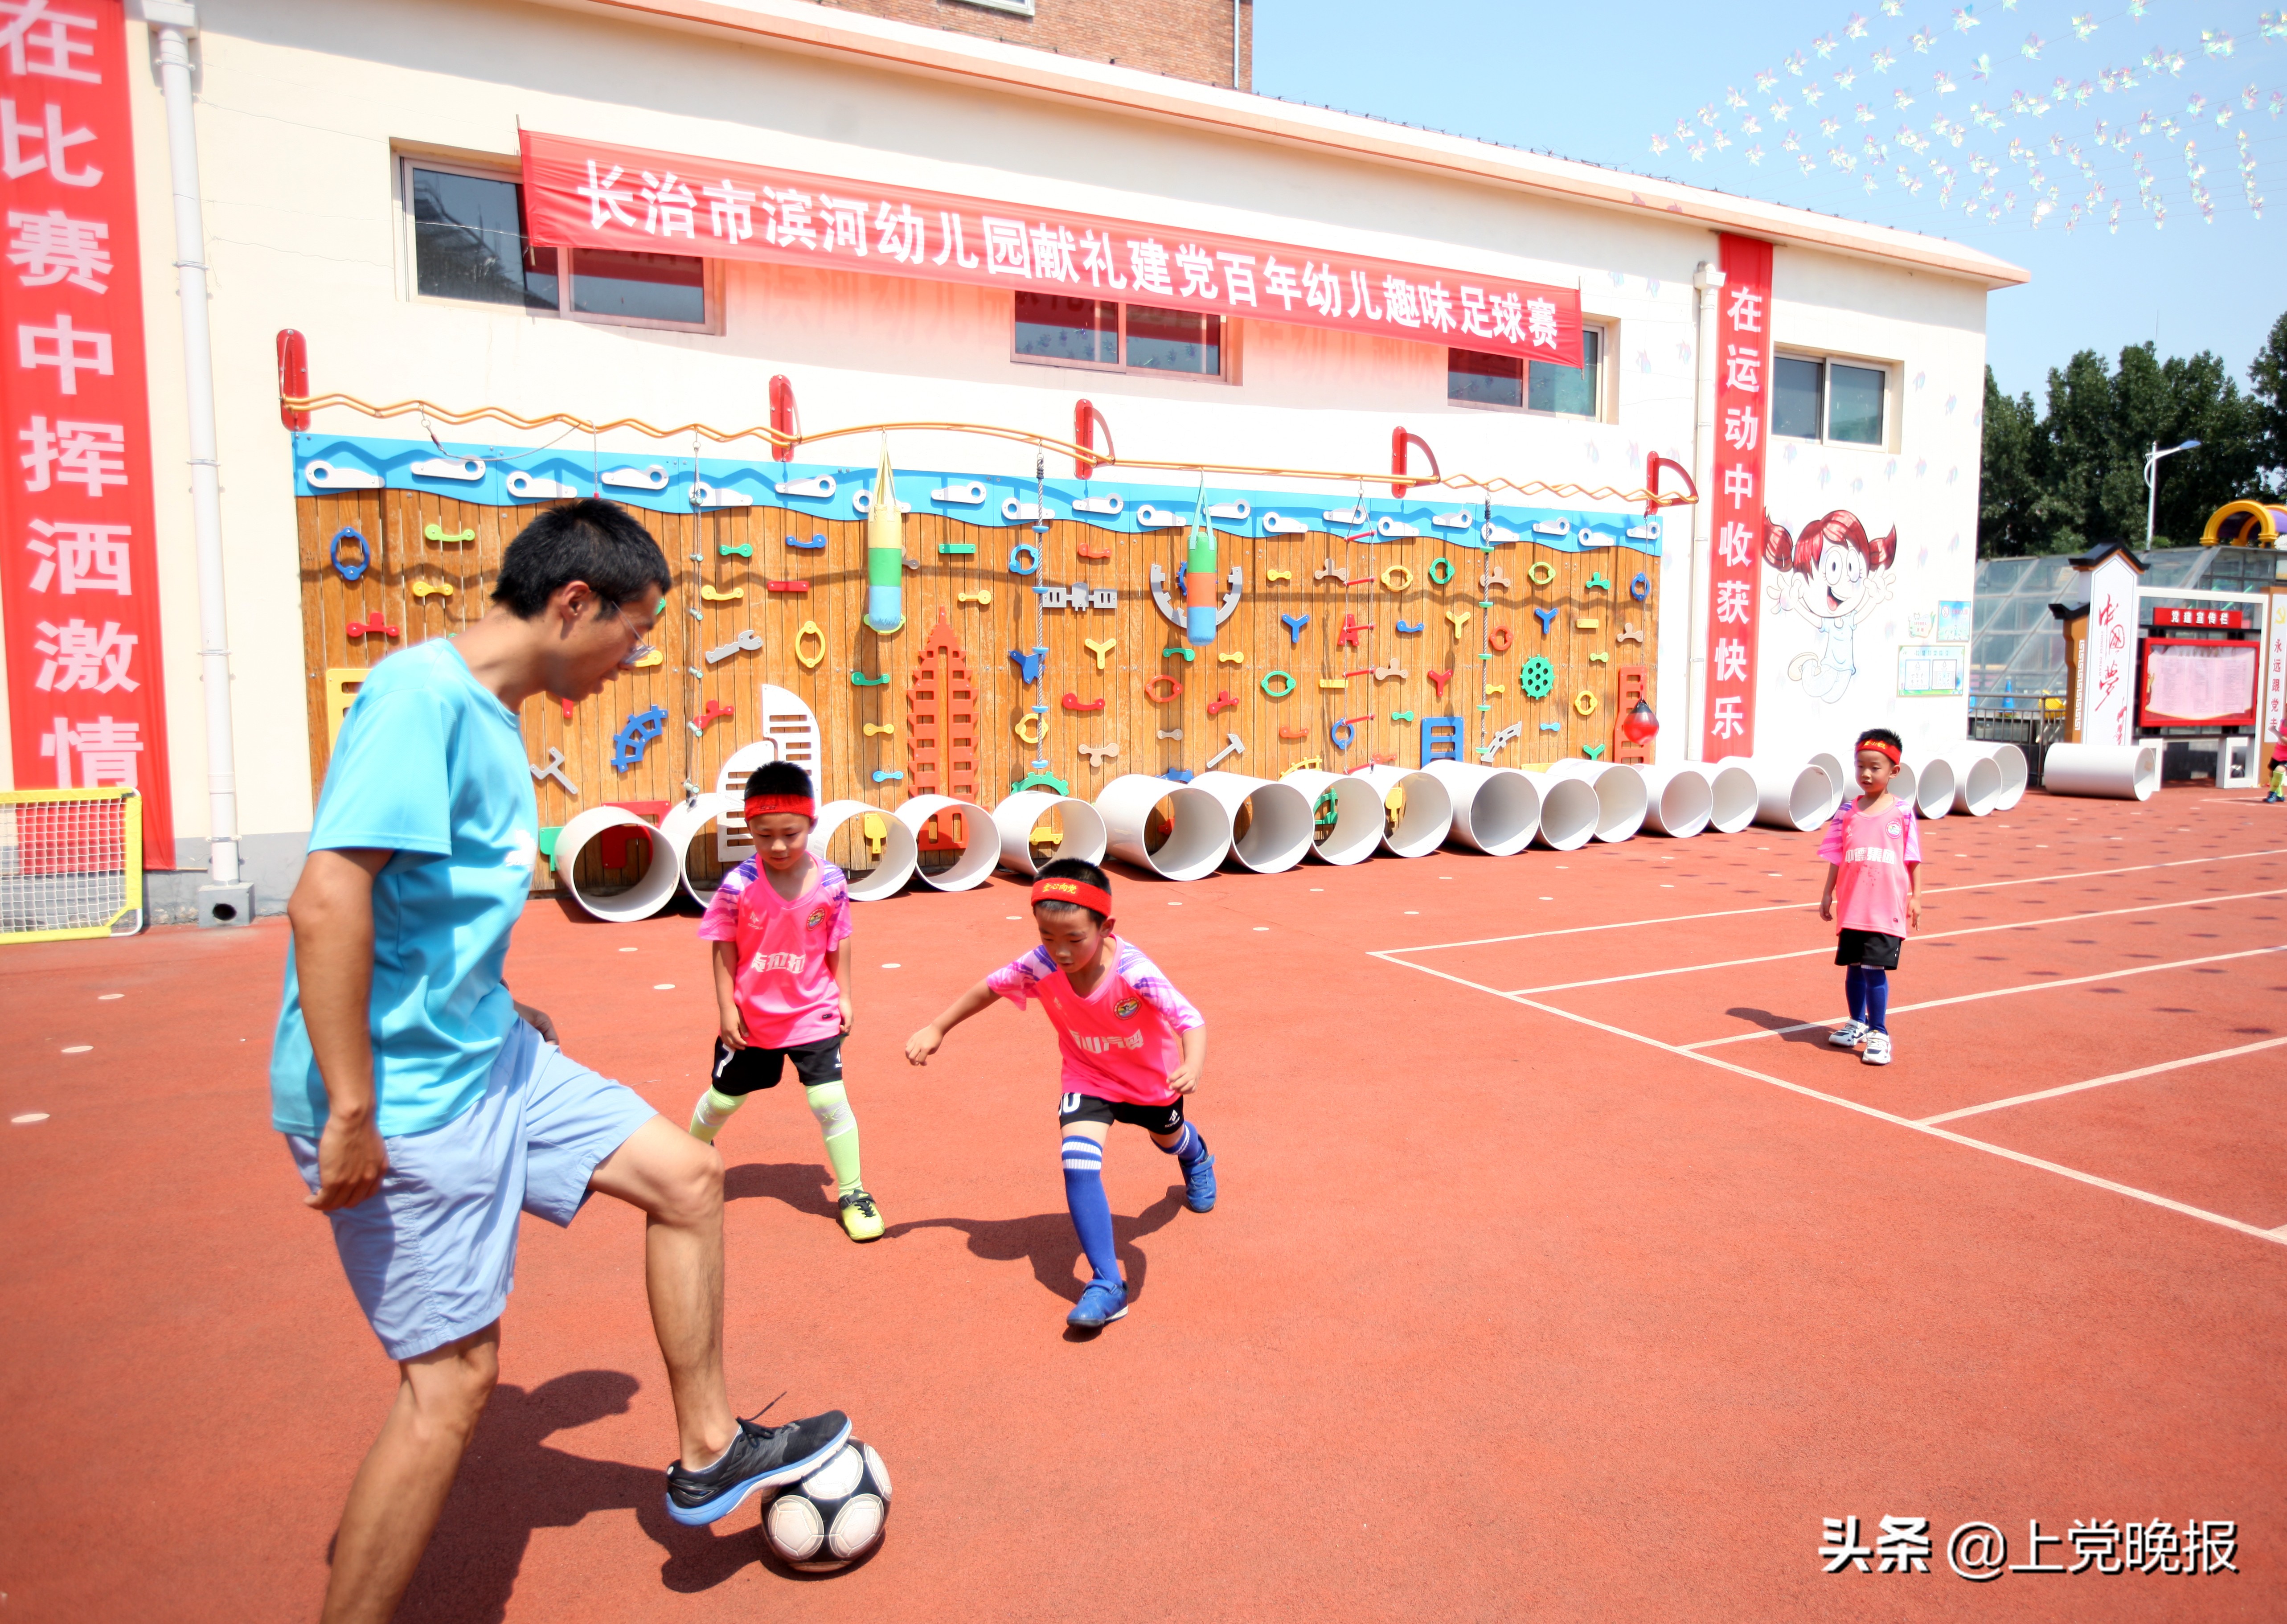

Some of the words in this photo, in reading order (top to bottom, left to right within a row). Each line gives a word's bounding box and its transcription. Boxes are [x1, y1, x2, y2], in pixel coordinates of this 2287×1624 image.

[578, 160, 1558, 350] 长治市滨河幼儿园献礼建党百年幼儿趣味足球赛
[0, 0, 143, 788] 在比赛中挥洒激情
[1711, 286, 1762, 739] 在运动中收获快乐
[2171, 610, 2229, 625] 党建宣传栏
[1042, 882, 1078, 894] 童心向党
